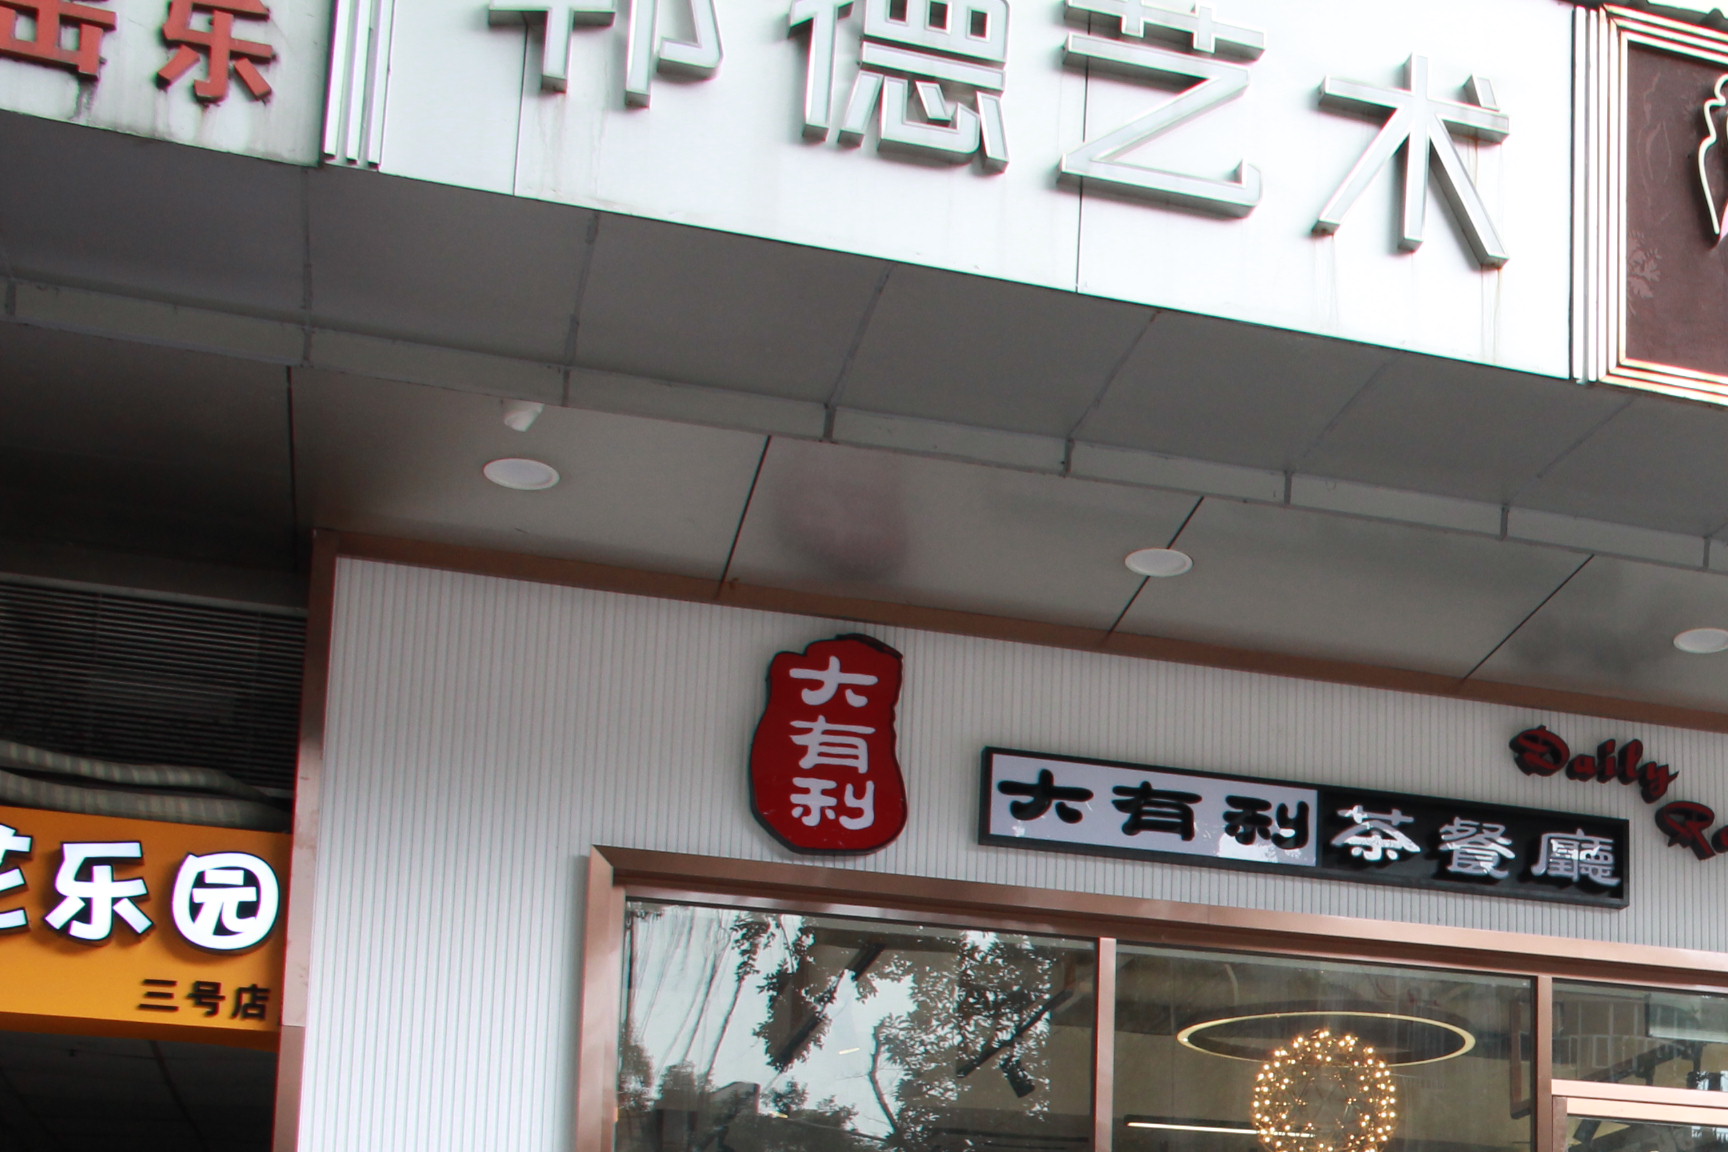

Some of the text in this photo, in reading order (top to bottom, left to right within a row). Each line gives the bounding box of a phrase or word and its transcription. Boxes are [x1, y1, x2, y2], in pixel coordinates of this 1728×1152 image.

[788, 654, 879, 831] 大有利
[1508, 725, 1680, 804] Daily
[135, 977, 272, 1022] 三号店
